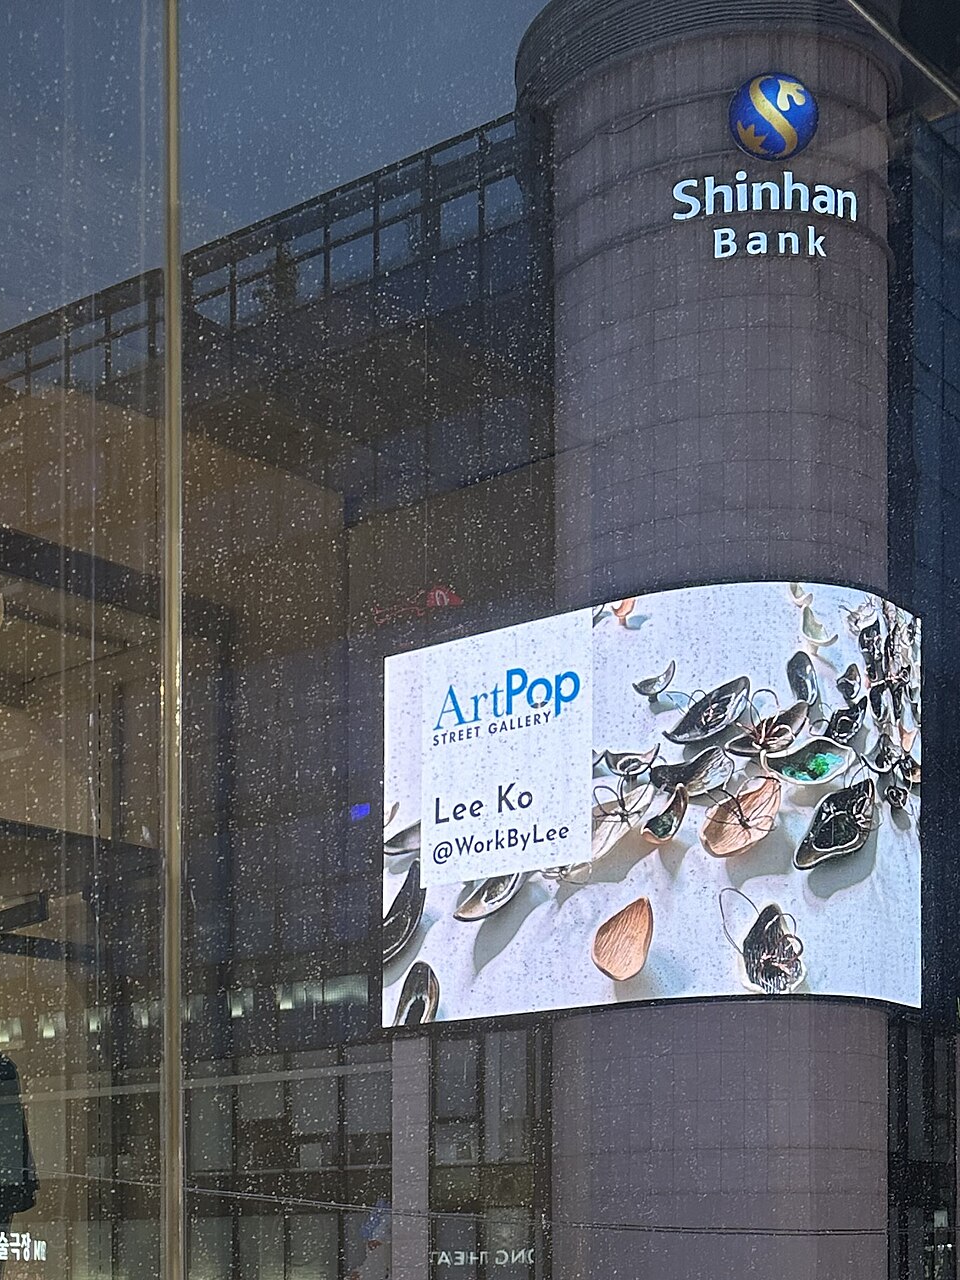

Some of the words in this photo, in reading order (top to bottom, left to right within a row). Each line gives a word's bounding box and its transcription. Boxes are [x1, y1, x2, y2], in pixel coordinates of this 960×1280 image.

[672, 170, 857, 222] Shinhan
[713, 225, 827, 259] Bank
[433, 668, 580, 731] ArtPop
[433, 726, 481, 746] STREET
[488, 711, 552, 735] GALLERY
[435, 797, 484, 824] Lee
[498, 782, 533, 813] Ko
[433, 824, 570, 865] @WorkByLee
